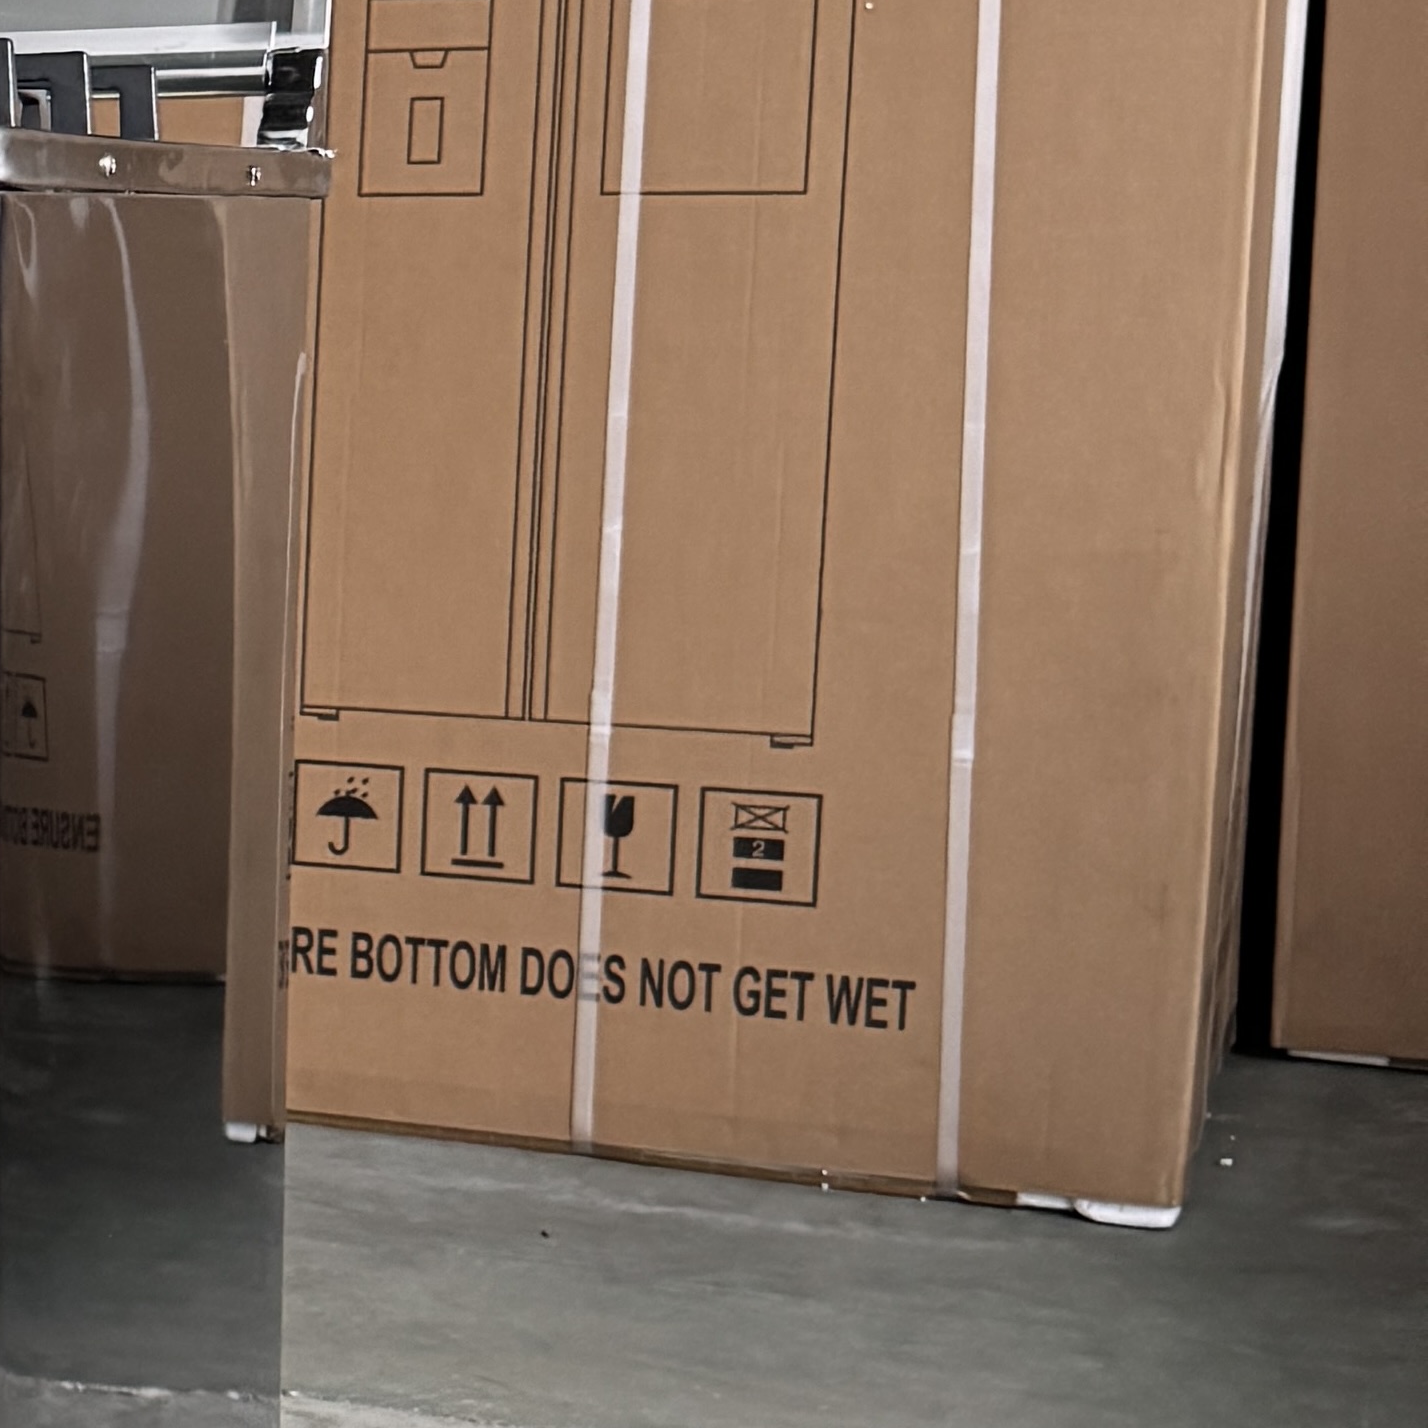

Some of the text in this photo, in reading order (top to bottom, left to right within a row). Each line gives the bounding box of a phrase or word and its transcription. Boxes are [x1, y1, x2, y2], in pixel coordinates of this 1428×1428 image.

[350, 931, 508, 995] BOTTOM
[520, 949, 626, 1005] DOES
[638, 958, 722, 1014] NOT
[733, 965, 813, 1022] GET
[826, 975, 916, 1032] WET
